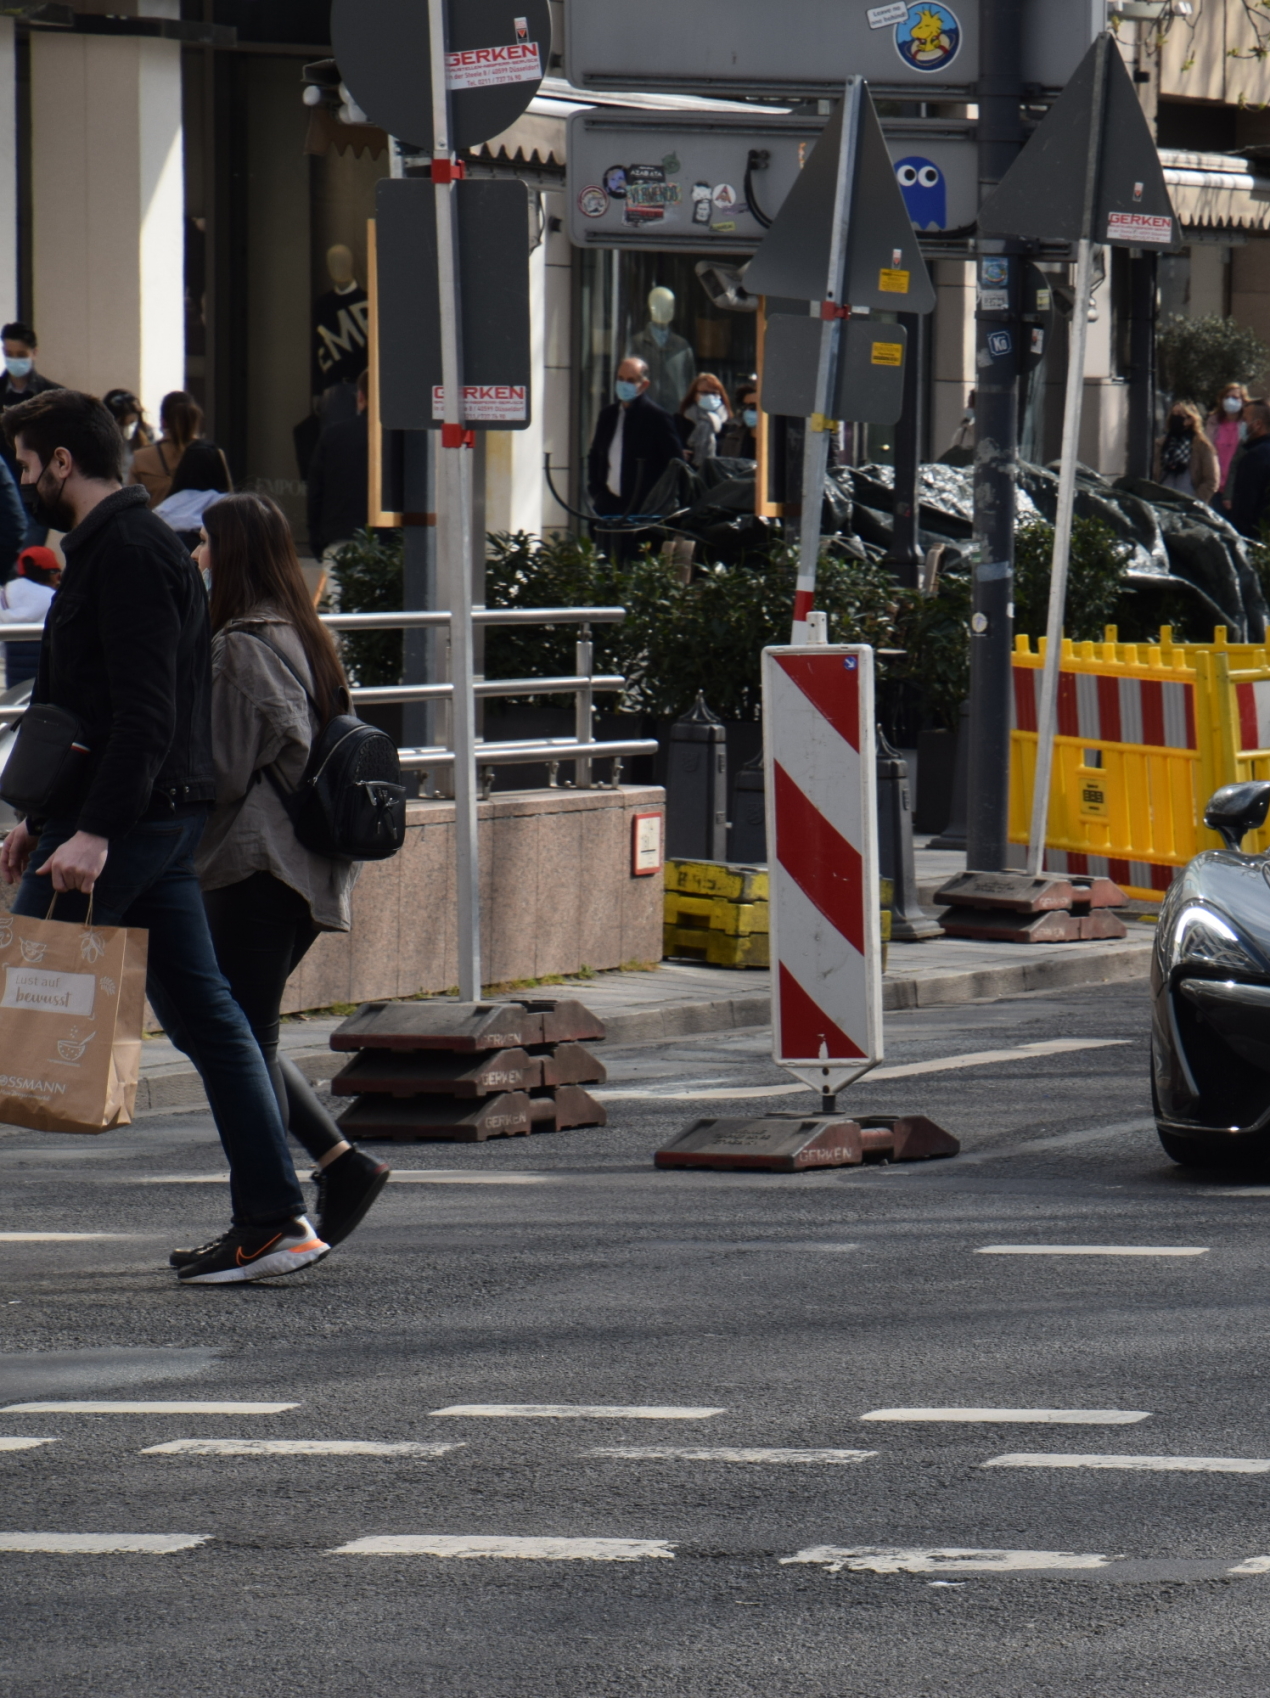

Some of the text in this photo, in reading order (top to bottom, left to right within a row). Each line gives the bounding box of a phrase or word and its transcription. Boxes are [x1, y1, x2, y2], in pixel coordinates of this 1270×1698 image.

[444, 43, 538, 68] GERKEN
[1109, 213, 1171, 227] GERKEN
[433, 386, 524, 400] GRKEN
[15, 974, 61, 988] Lust auf
[15, 987, 72, 1008] bewusst
[485, 1112, 527, 1129] GERKEN
[800, 1147, 852, 1162] GERKEN
